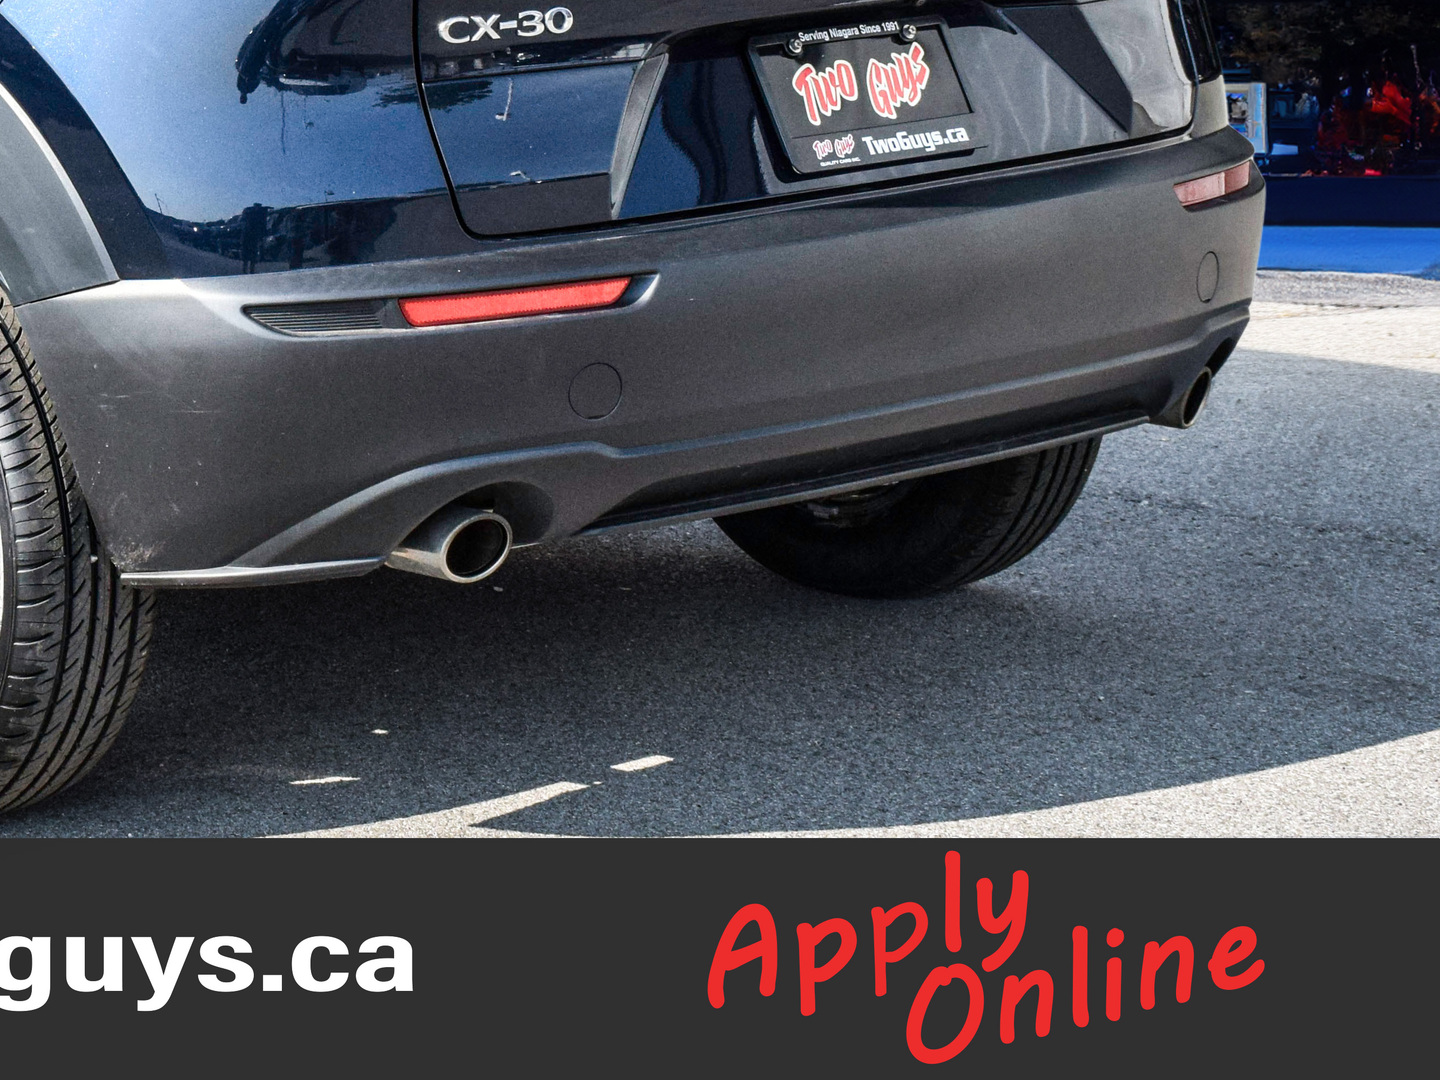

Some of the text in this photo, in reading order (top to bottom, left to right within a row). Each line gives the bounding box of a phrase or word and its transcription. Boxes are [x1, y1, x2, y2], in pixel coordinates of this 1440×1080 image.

[436, 6, 574, 44] CX-30
[798, 20, 900, 41] Serving Niagara Since 1991
[861, 126, 971, 156] TwoGuys.ca
